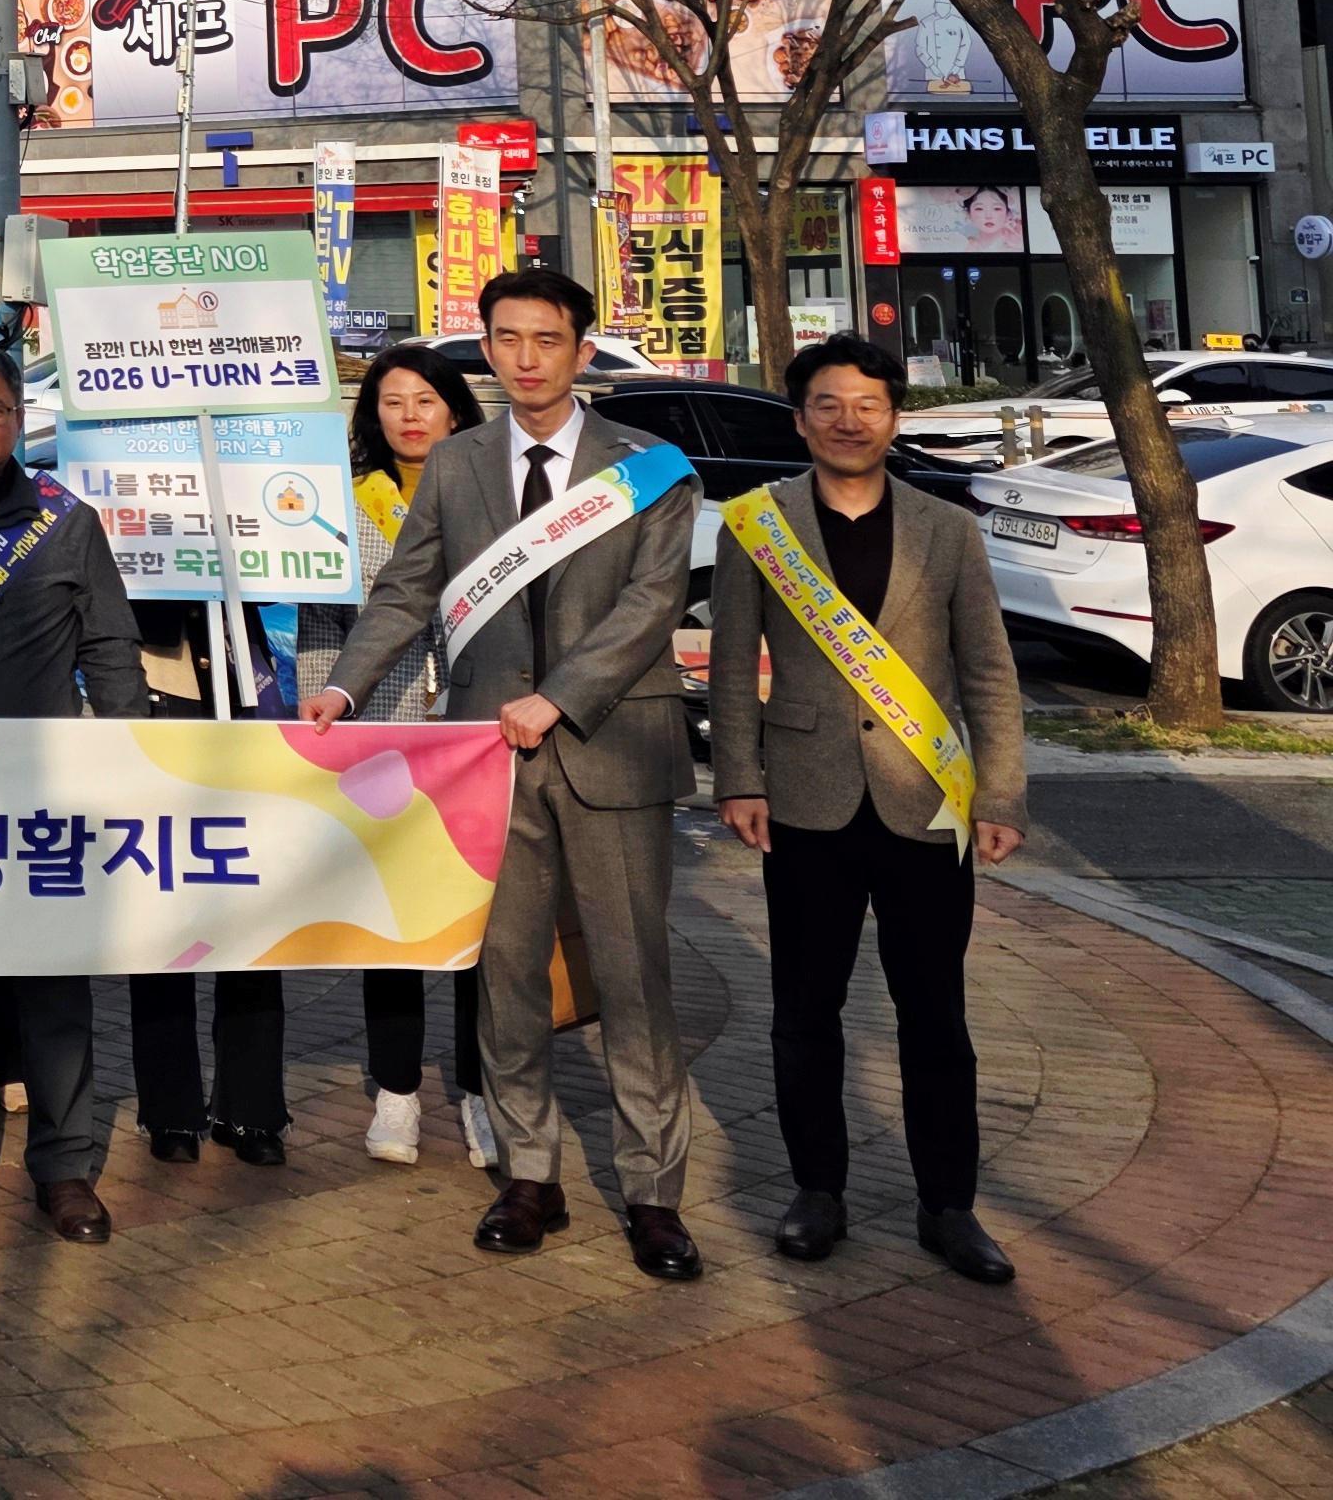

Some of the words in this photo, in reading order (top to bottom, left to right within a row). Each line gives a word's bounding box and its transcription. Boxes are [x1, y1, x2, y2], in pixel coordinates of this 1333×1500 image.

[905, 128, 1005, 150] HANS
[1242, 149, 1269, 166] PC
[614, 163, 709, 206] SKT
[334, 202, 354, 285] TV
[447, 193, 475, 297] 휴대폰
[91, 245, 204, 278] 학업중단
[211, 245, 268, 271] NO!
[84, 341, 124, 360] 잠깐!
[131, 339, 165, 358] 다시
[168, 338, 202, 357] 한번
[208, 335, 302, 355] 생각해볼까?
[77, 366, 144, 392] 2026
[151, 362, 262, 389] U-TURN
[269, 359, 322, 387] 스쿨
[126, 439, 169, 454] 2026
[252, 440, 284, 456] 스쿨
[82, 470, 139, 497] 나를
[489, 547, 530, 586] 게임이
[466, 579, 495, 607] 아닌
[756, 510, 789, 550] 작은
[783, 549, 836, 607] 관심과
[831, 607, 887, 661] 배려가
[753, 542, 803, 601] 행복한
[800, 603, 856, 665] 교실을
[849, 663, 923, 739] 만듭니다
